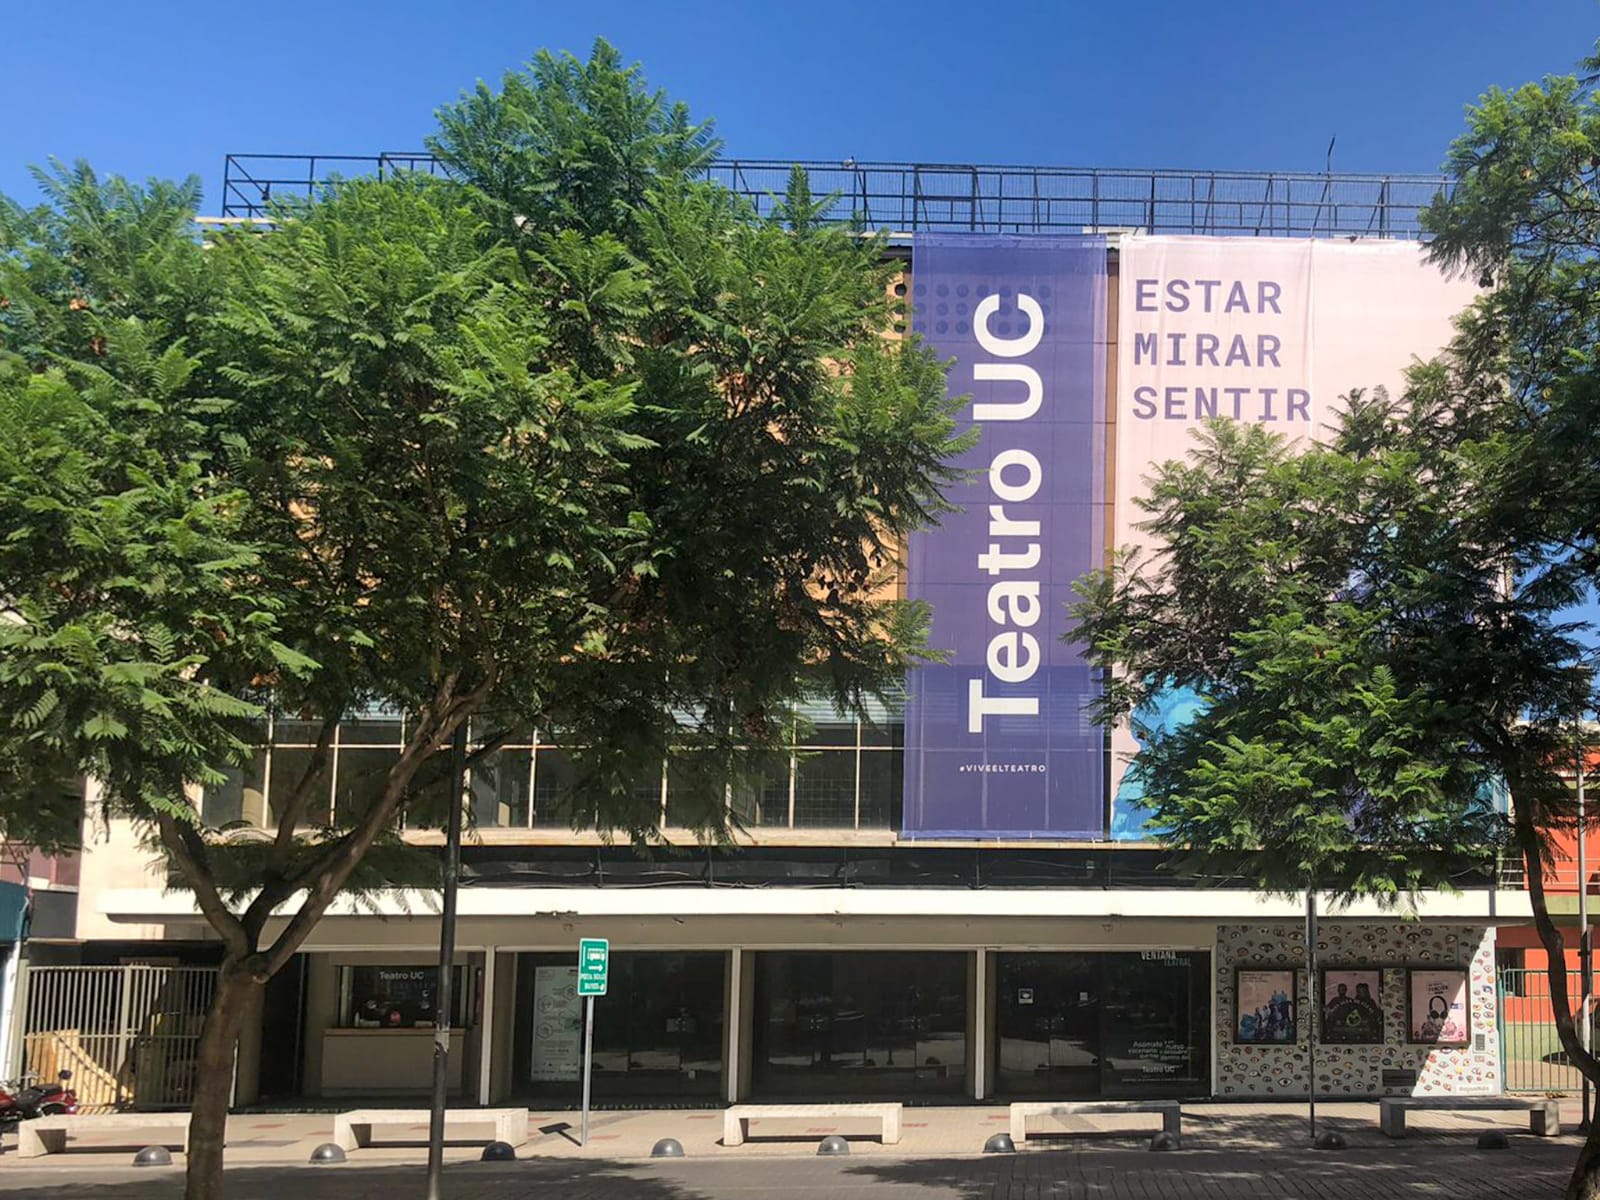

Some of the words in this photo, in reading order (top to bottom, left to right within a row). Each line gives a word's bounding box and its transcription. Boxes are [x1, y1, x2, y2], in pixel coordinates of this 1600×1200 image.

[1135, 279, 1282, 315] ESTAR
[973, 292, 1044, 423] UC
[1134, 332, 1281, 368] MIRAR
[1132, 386, 1311, 422] SENTIR
[968, 448, 1043, 734] Teatro
[959, 764, 1047, 773] #VIVEELTEATRO
[379, 971, 408, 980] Teatro
[410, 971, 424, 980] UC
